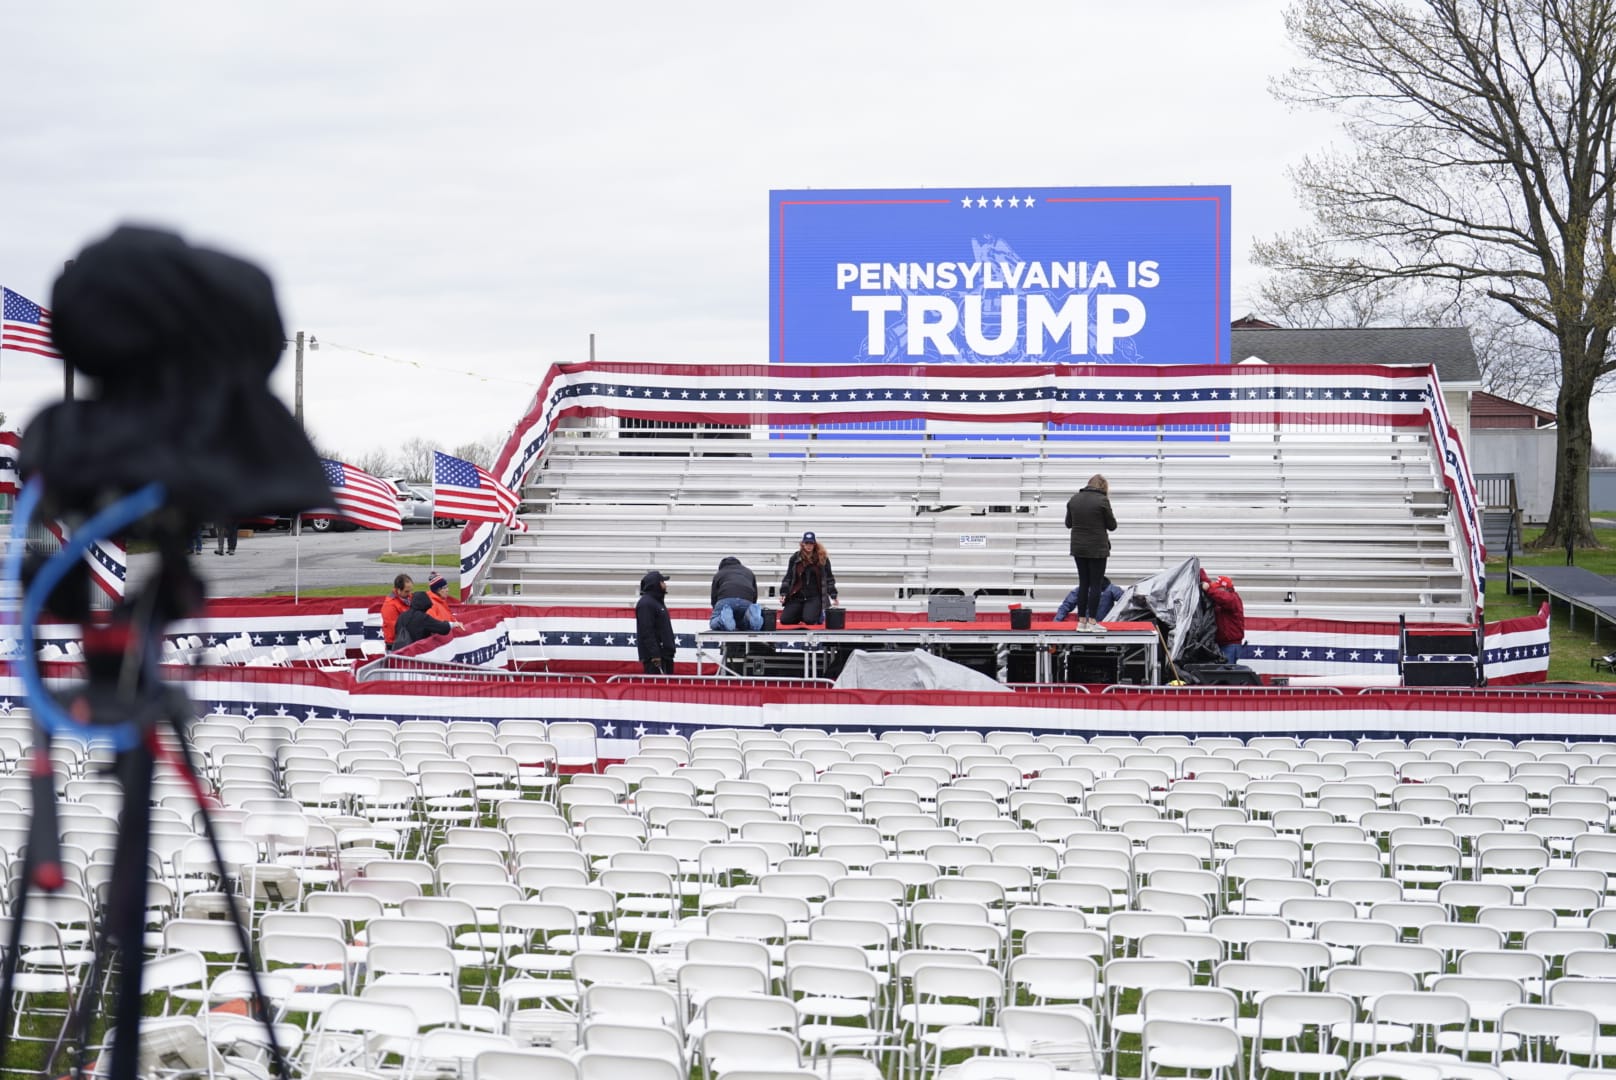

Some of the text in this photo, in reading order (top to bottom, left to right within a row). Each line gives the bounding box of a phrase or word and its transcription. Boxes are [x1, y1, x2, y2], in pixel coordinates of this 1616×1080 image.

[836, 260, 1160, 290] PENNSYLVANIA IS
[851, 294, 1147, 356] TRUMP
